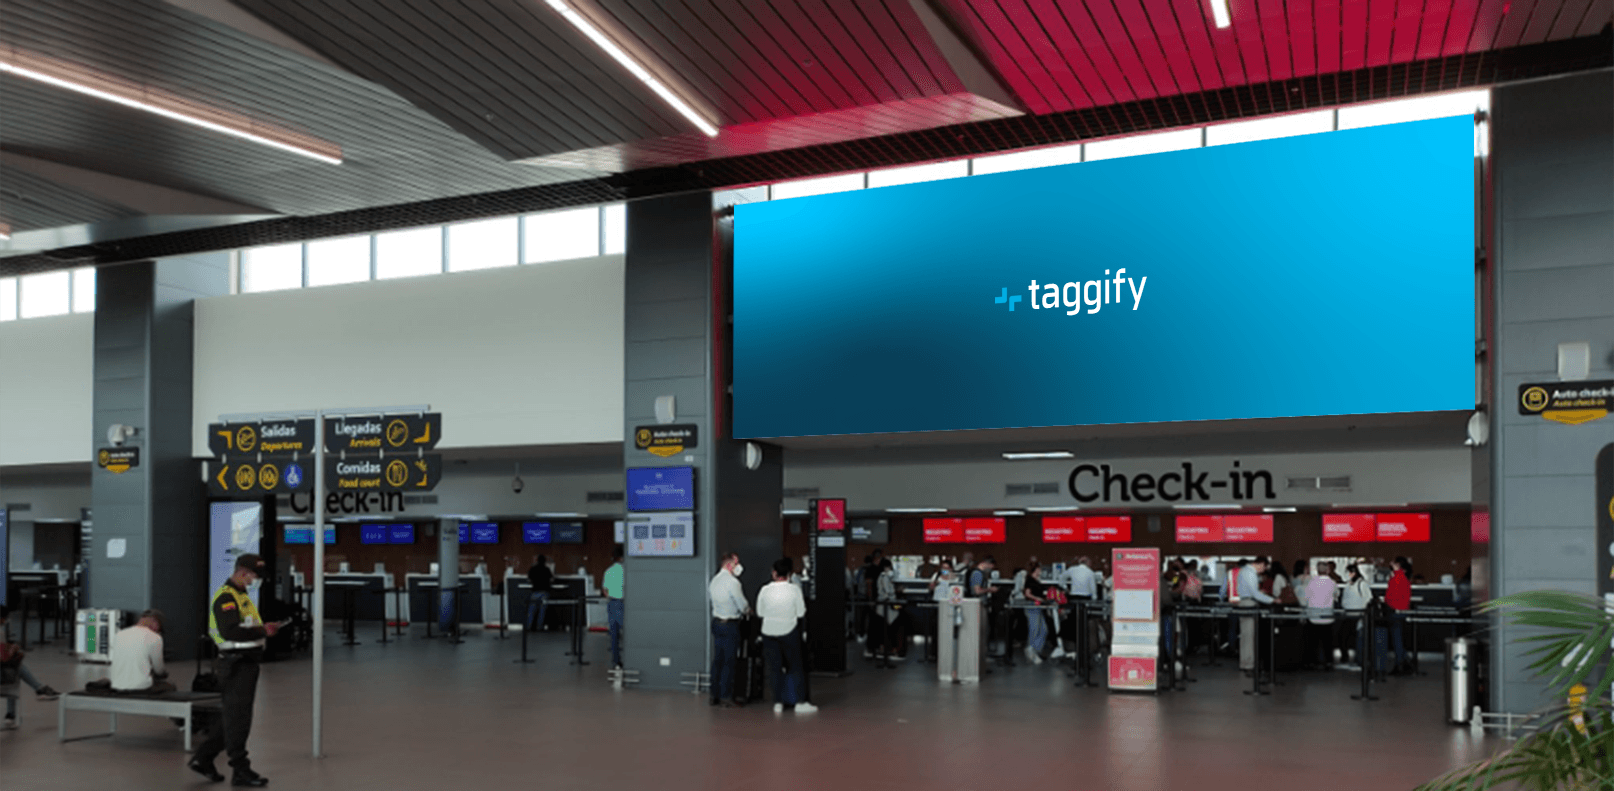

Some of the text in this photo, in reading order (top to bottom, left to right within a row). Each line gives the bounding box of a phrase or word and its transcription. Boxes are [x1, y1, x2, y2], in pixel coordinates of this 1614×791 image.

[1028, 268, 1148, 316] taggify
[1552, 389, 1578, 399] Auto
[260, 424, 296, 438] Salidas
[335, 421, 382, 437] Llegadas
[336, 460, 381, 475] Comidas
[1068, 460, 1276, 503] Check-in
